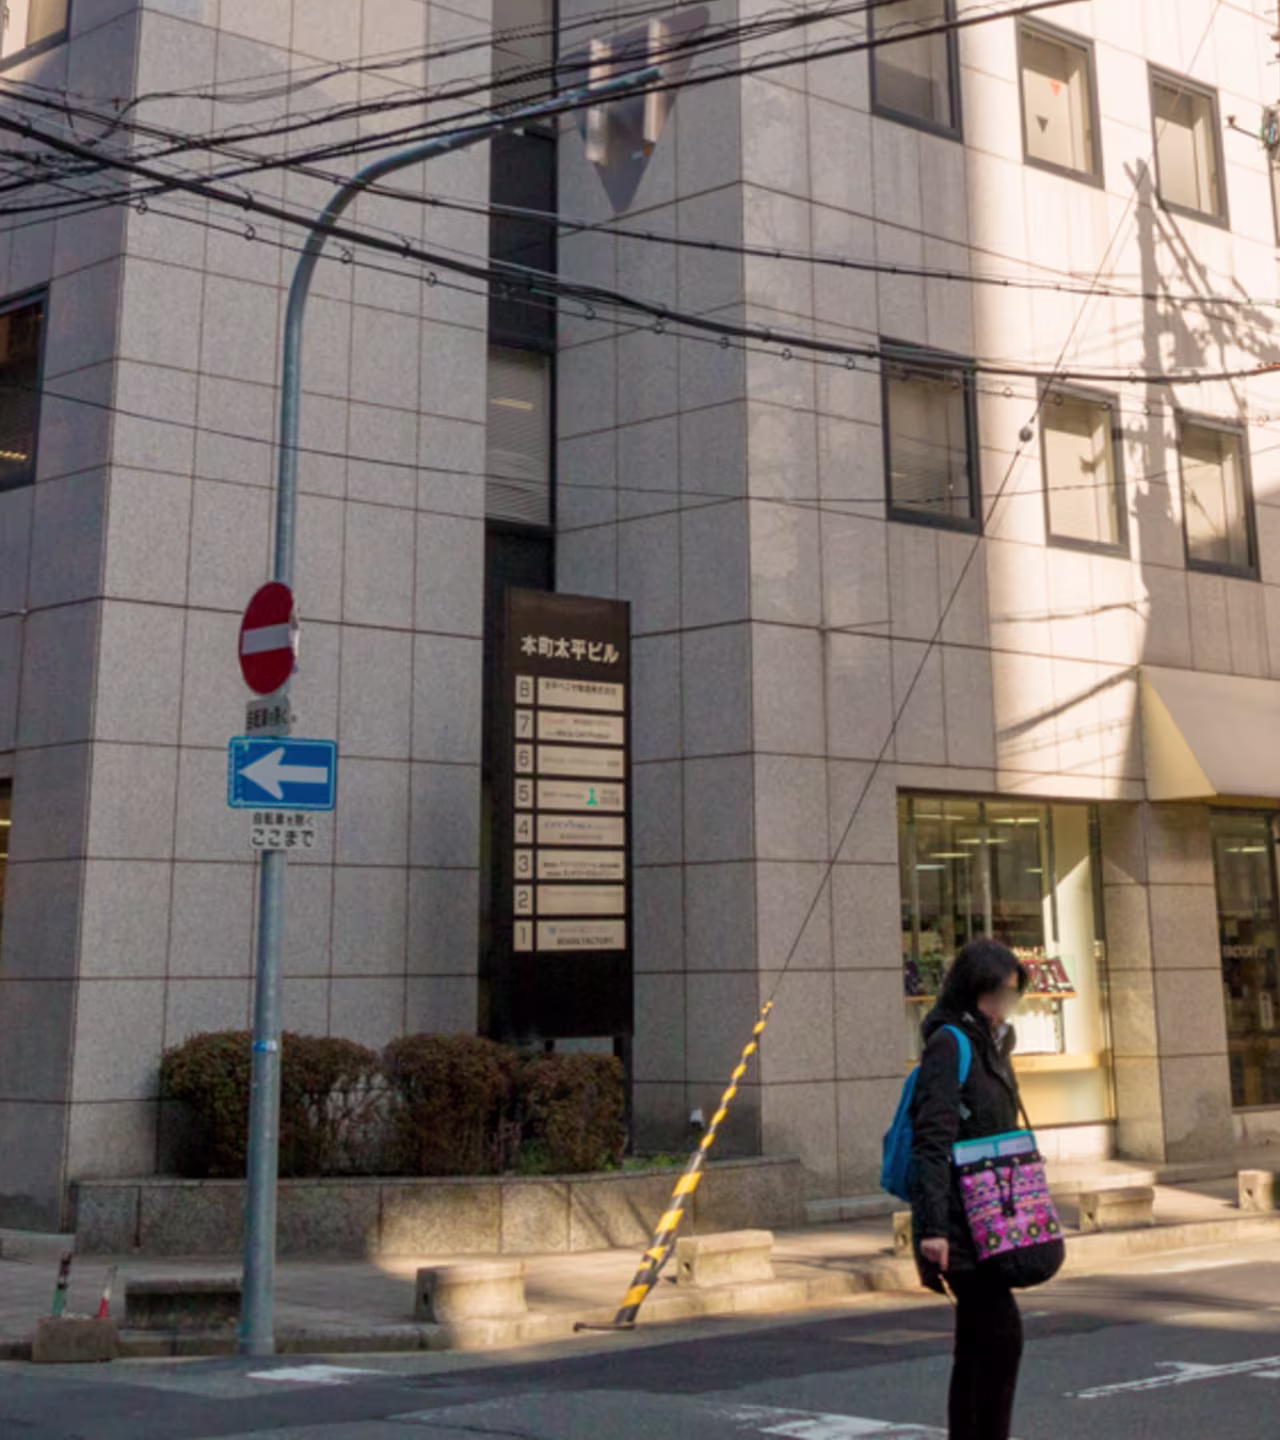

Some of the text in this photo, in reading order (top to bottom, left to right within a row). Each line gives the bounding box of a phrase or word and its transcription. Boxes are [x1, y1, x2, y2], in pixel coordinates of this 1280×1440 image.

[521, 634, 619, 663] 本町太平ビル
[252, 828, 315, 848] ここまで
